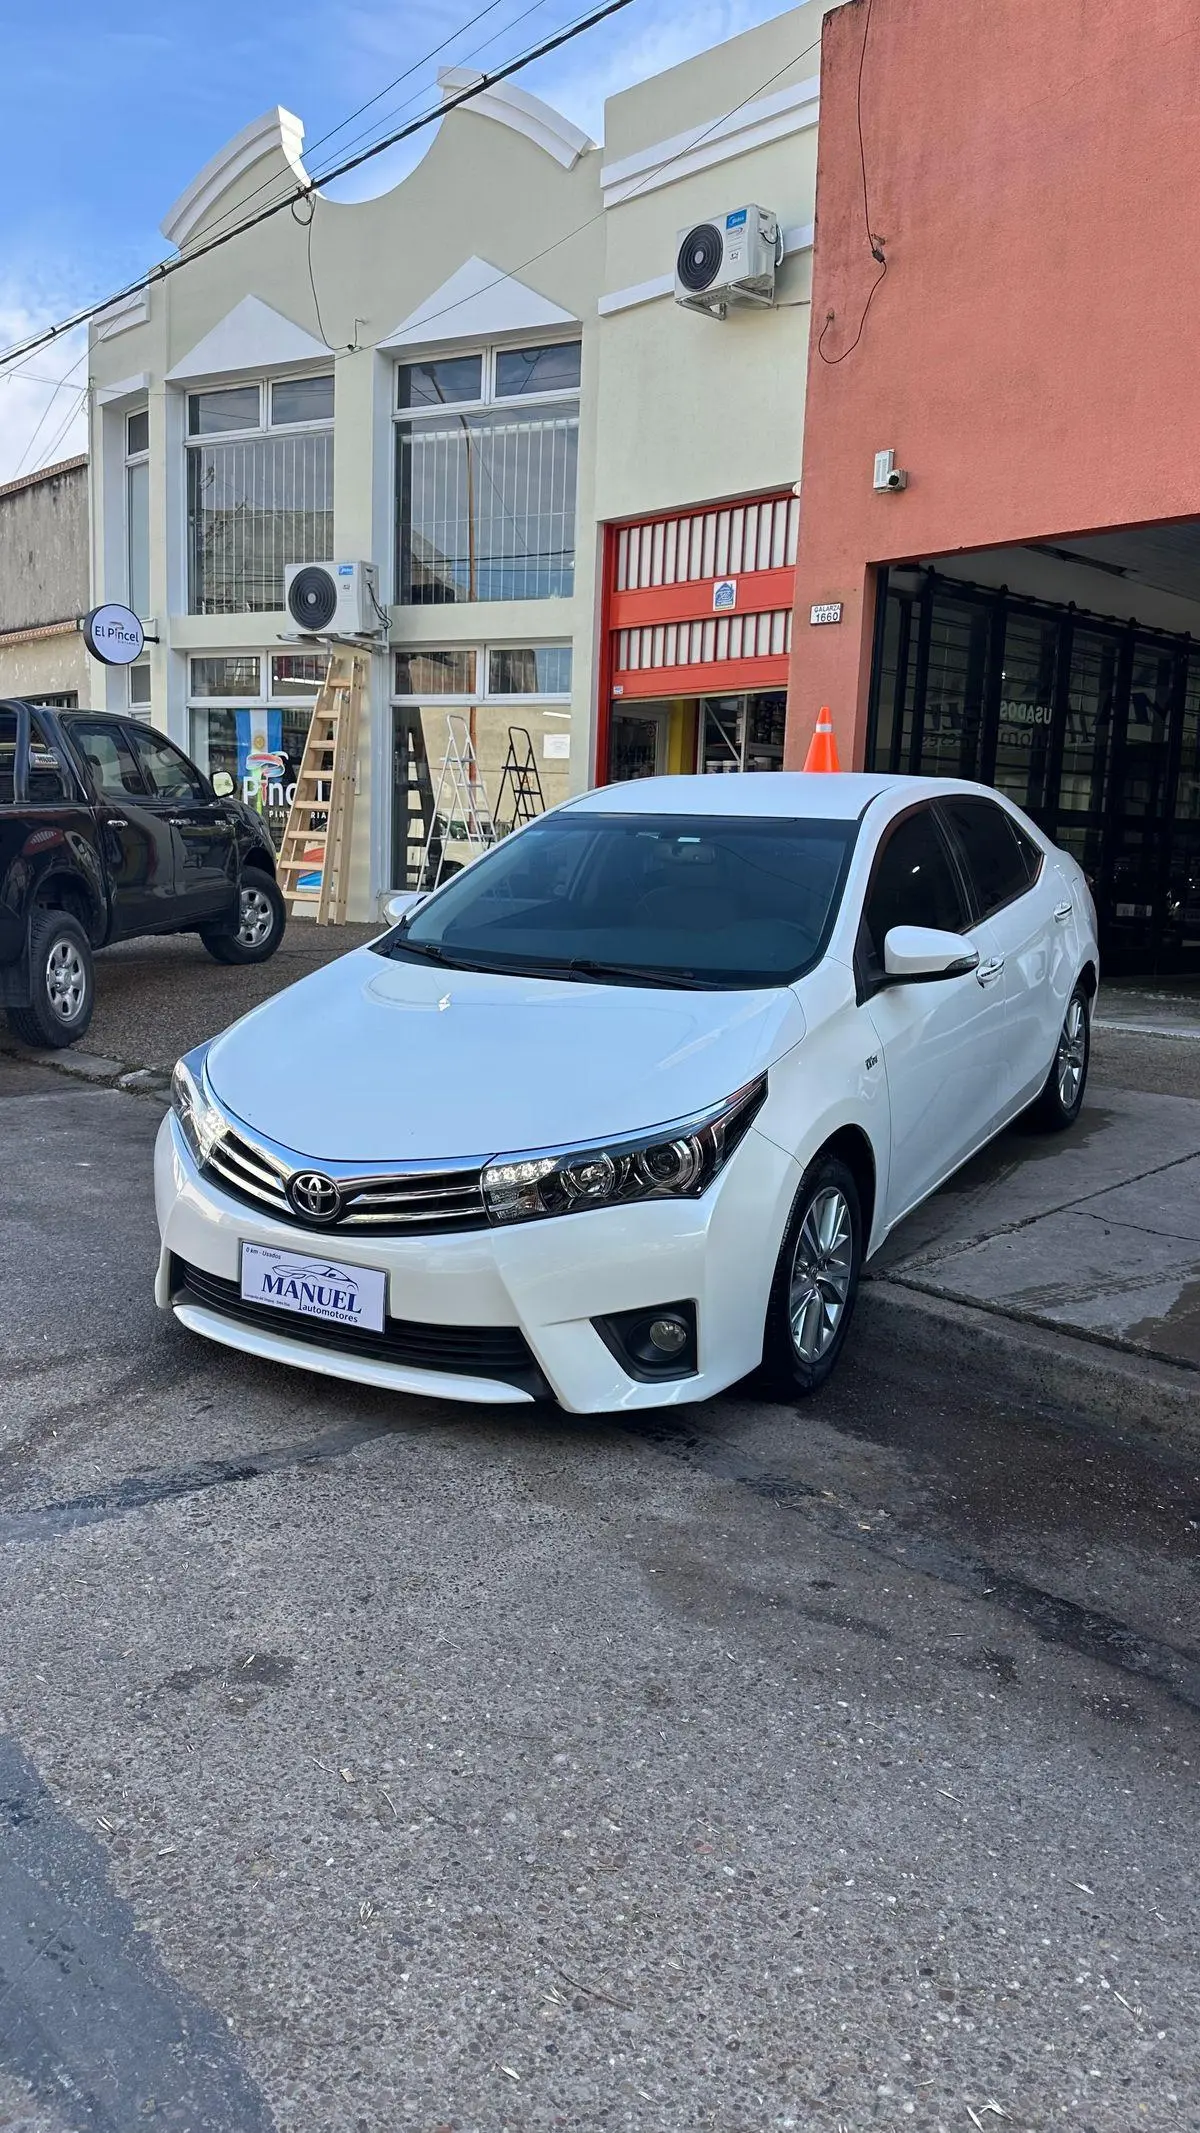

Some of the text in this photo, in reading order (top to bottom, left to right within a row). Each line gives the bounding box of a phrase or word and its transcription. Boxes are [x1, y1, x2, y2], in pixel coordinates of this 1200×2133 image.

[814, 605, 841, 613] GALARZA
[816, 612, 839, 622] 1660
[95, 625, 139, 642] El Pincel
[243, 775, 323, 806] Pincl
[262, 1250, 281, 1260] Usados
[261, 1273, 362, 1313] MANUEL
[302, 1304, 359, 1323] automotores
